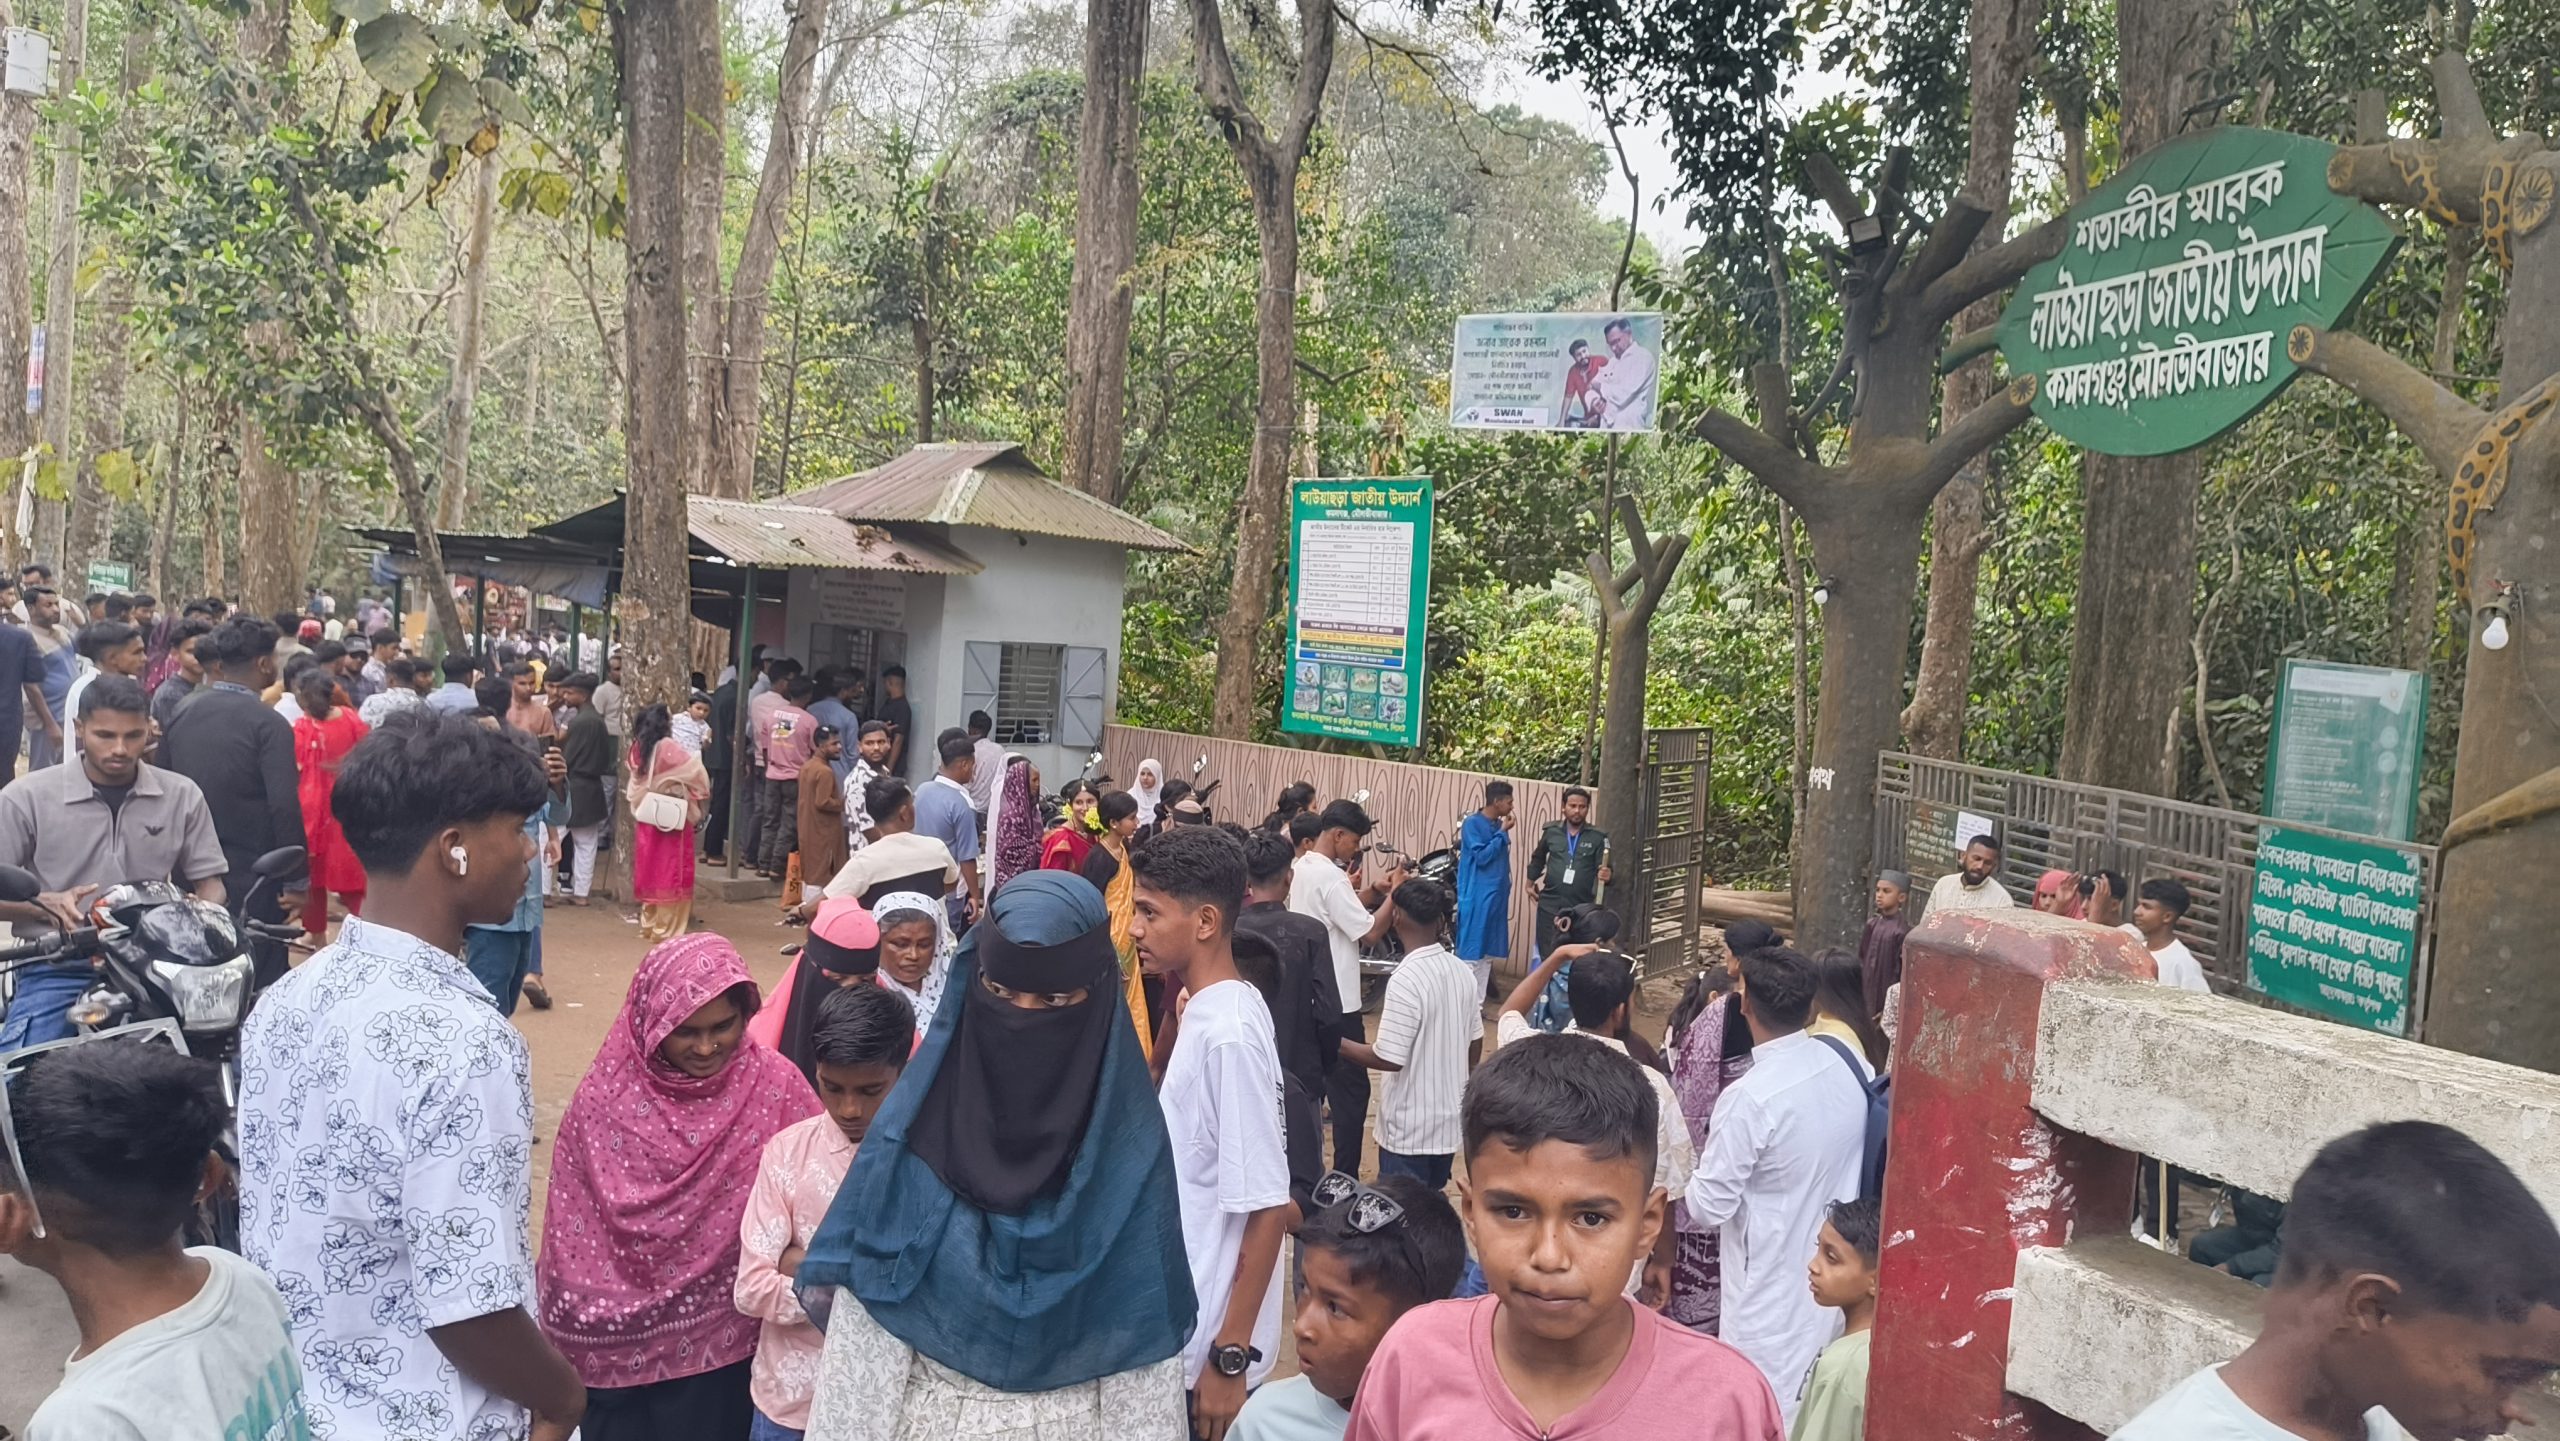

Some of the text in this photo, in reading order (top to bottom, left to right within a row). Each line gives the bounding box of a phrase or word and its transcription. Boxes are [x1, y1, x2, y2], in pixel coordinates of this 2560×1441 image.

[2075, 160, 2286, 254] শতাব্দীর স্মারক
[2029, 225, 2329, 352] লাউয়াছড়া জাতীয় উদ্যান
[2129, 331, 2275, 400] মৌলভীবাজার
[1494, 408, 1523, 417] SWAN
[1300, 486, 1424, 508] লাউয়াছড়া জাতীয় উদ্যান
